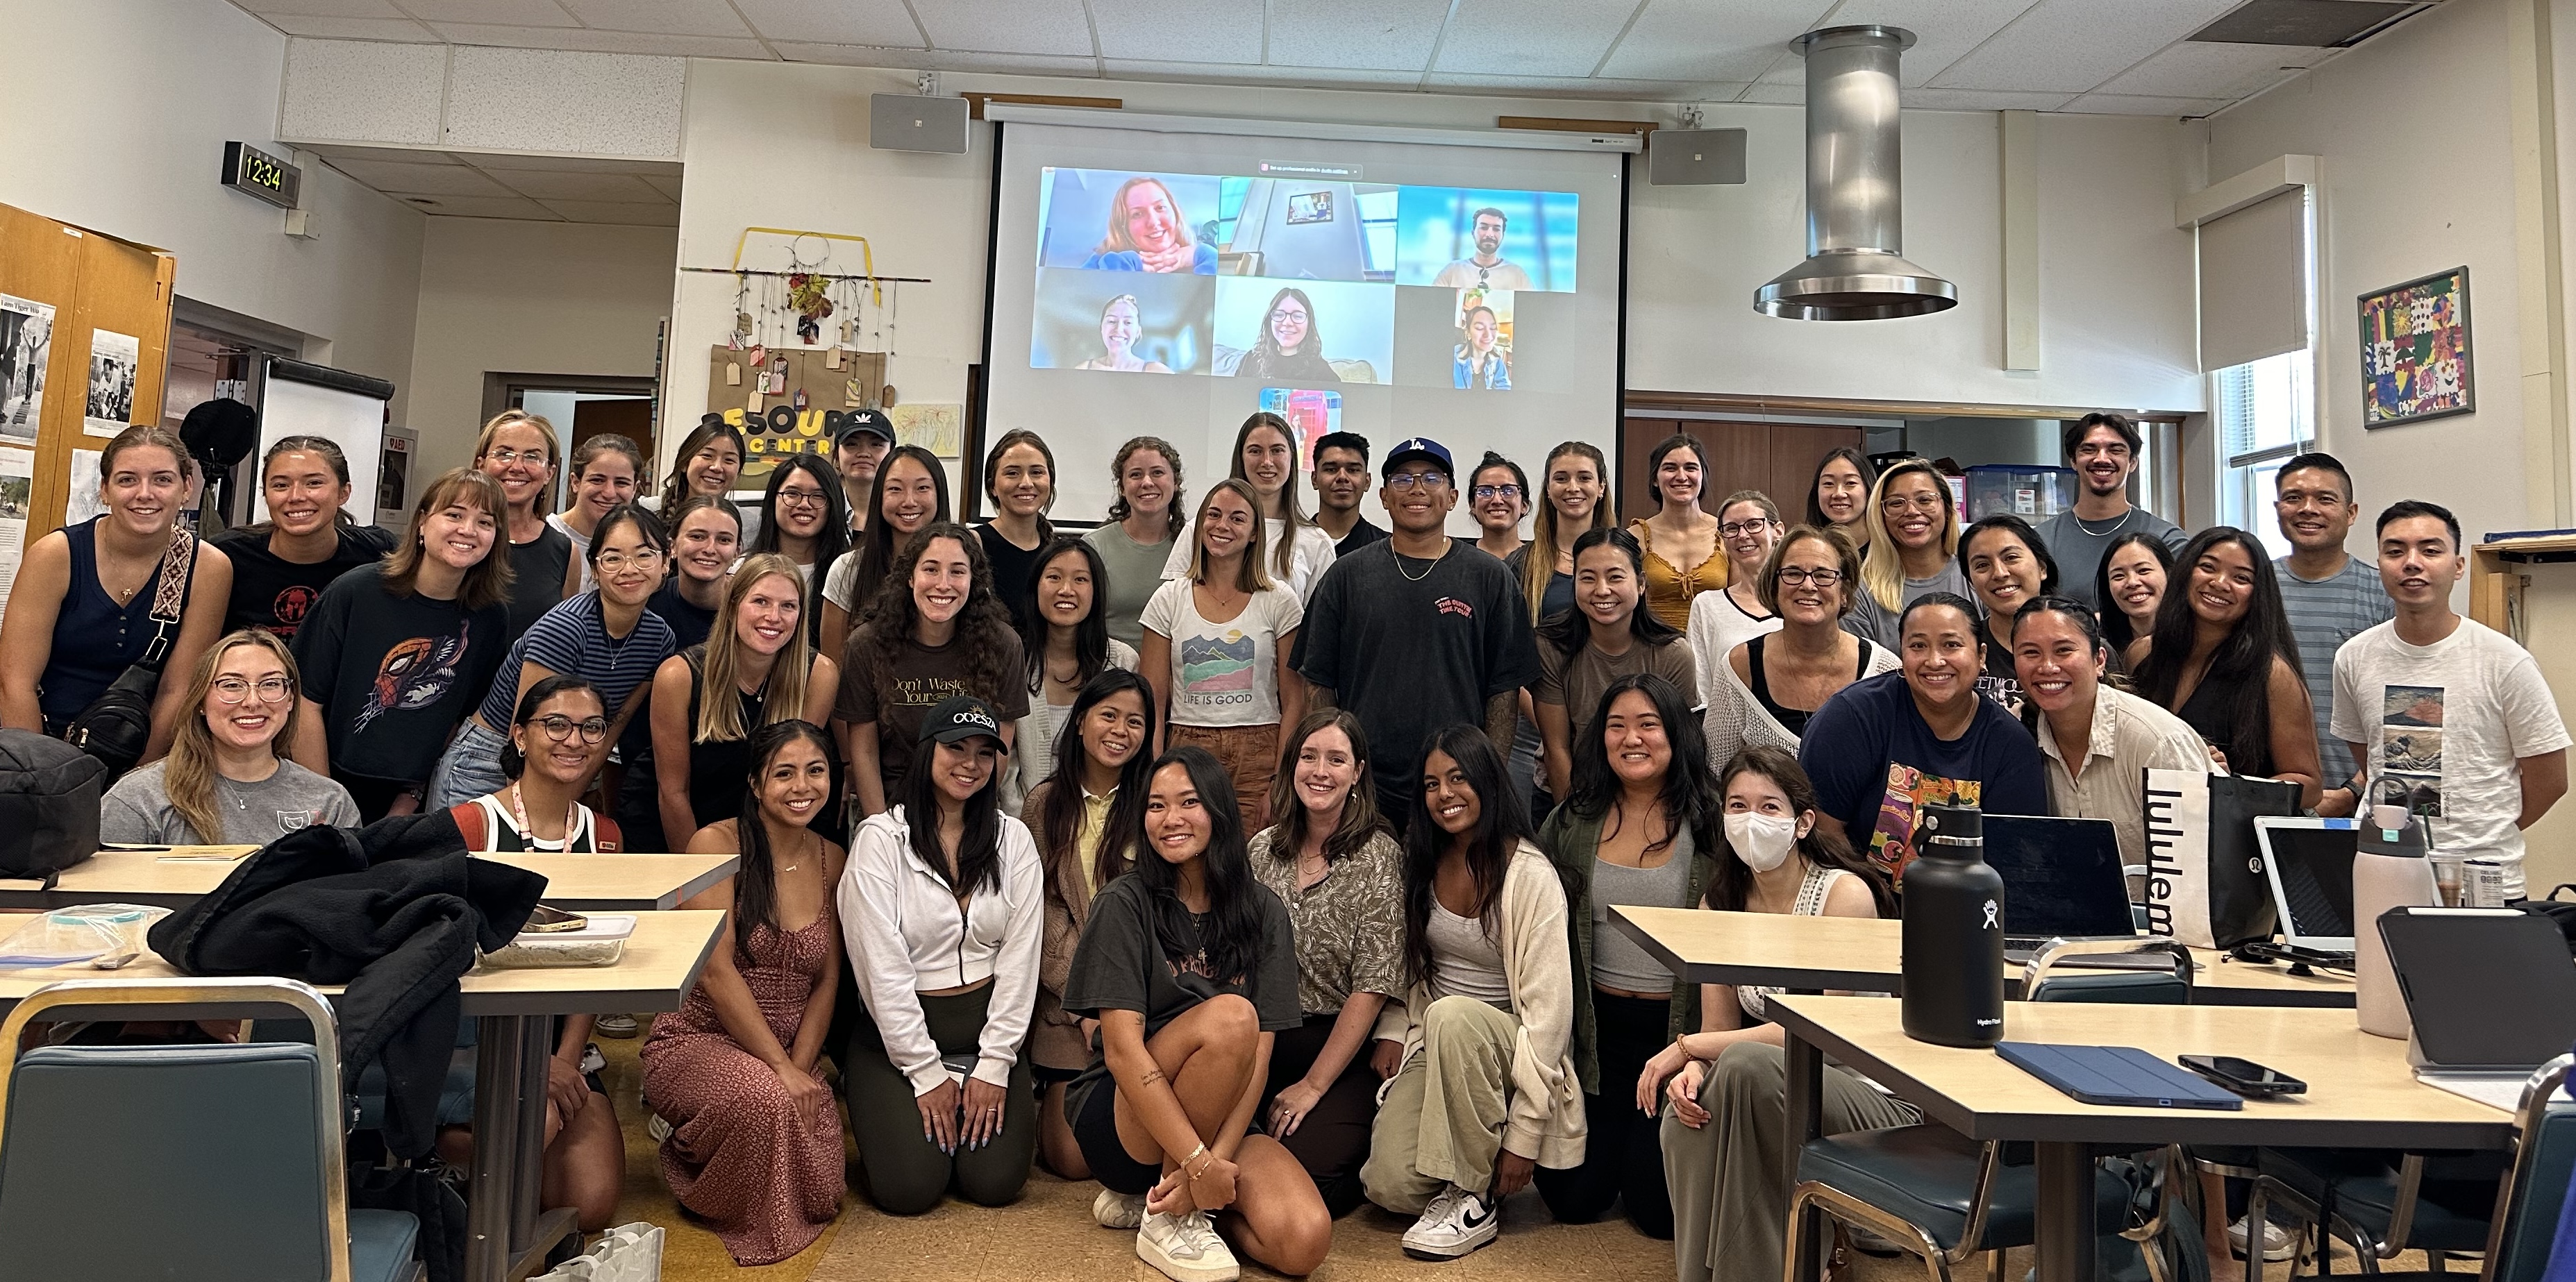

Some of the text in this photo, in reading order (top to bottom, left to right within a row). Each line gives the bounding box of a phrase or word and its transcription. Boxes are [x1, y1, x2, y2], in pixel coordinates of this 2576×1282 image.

[245, 155, 281, 191] 12:34
[394, 439, 405, 450] AED
[749, 438, 830, 455] CENTER
[1410, 438, 1425, 450] LA
[928, 677, 966, 691] Waste
[904, 690, 933, 703] Your
[1184, 694, 1253, 705] LIFE IS GOOD
